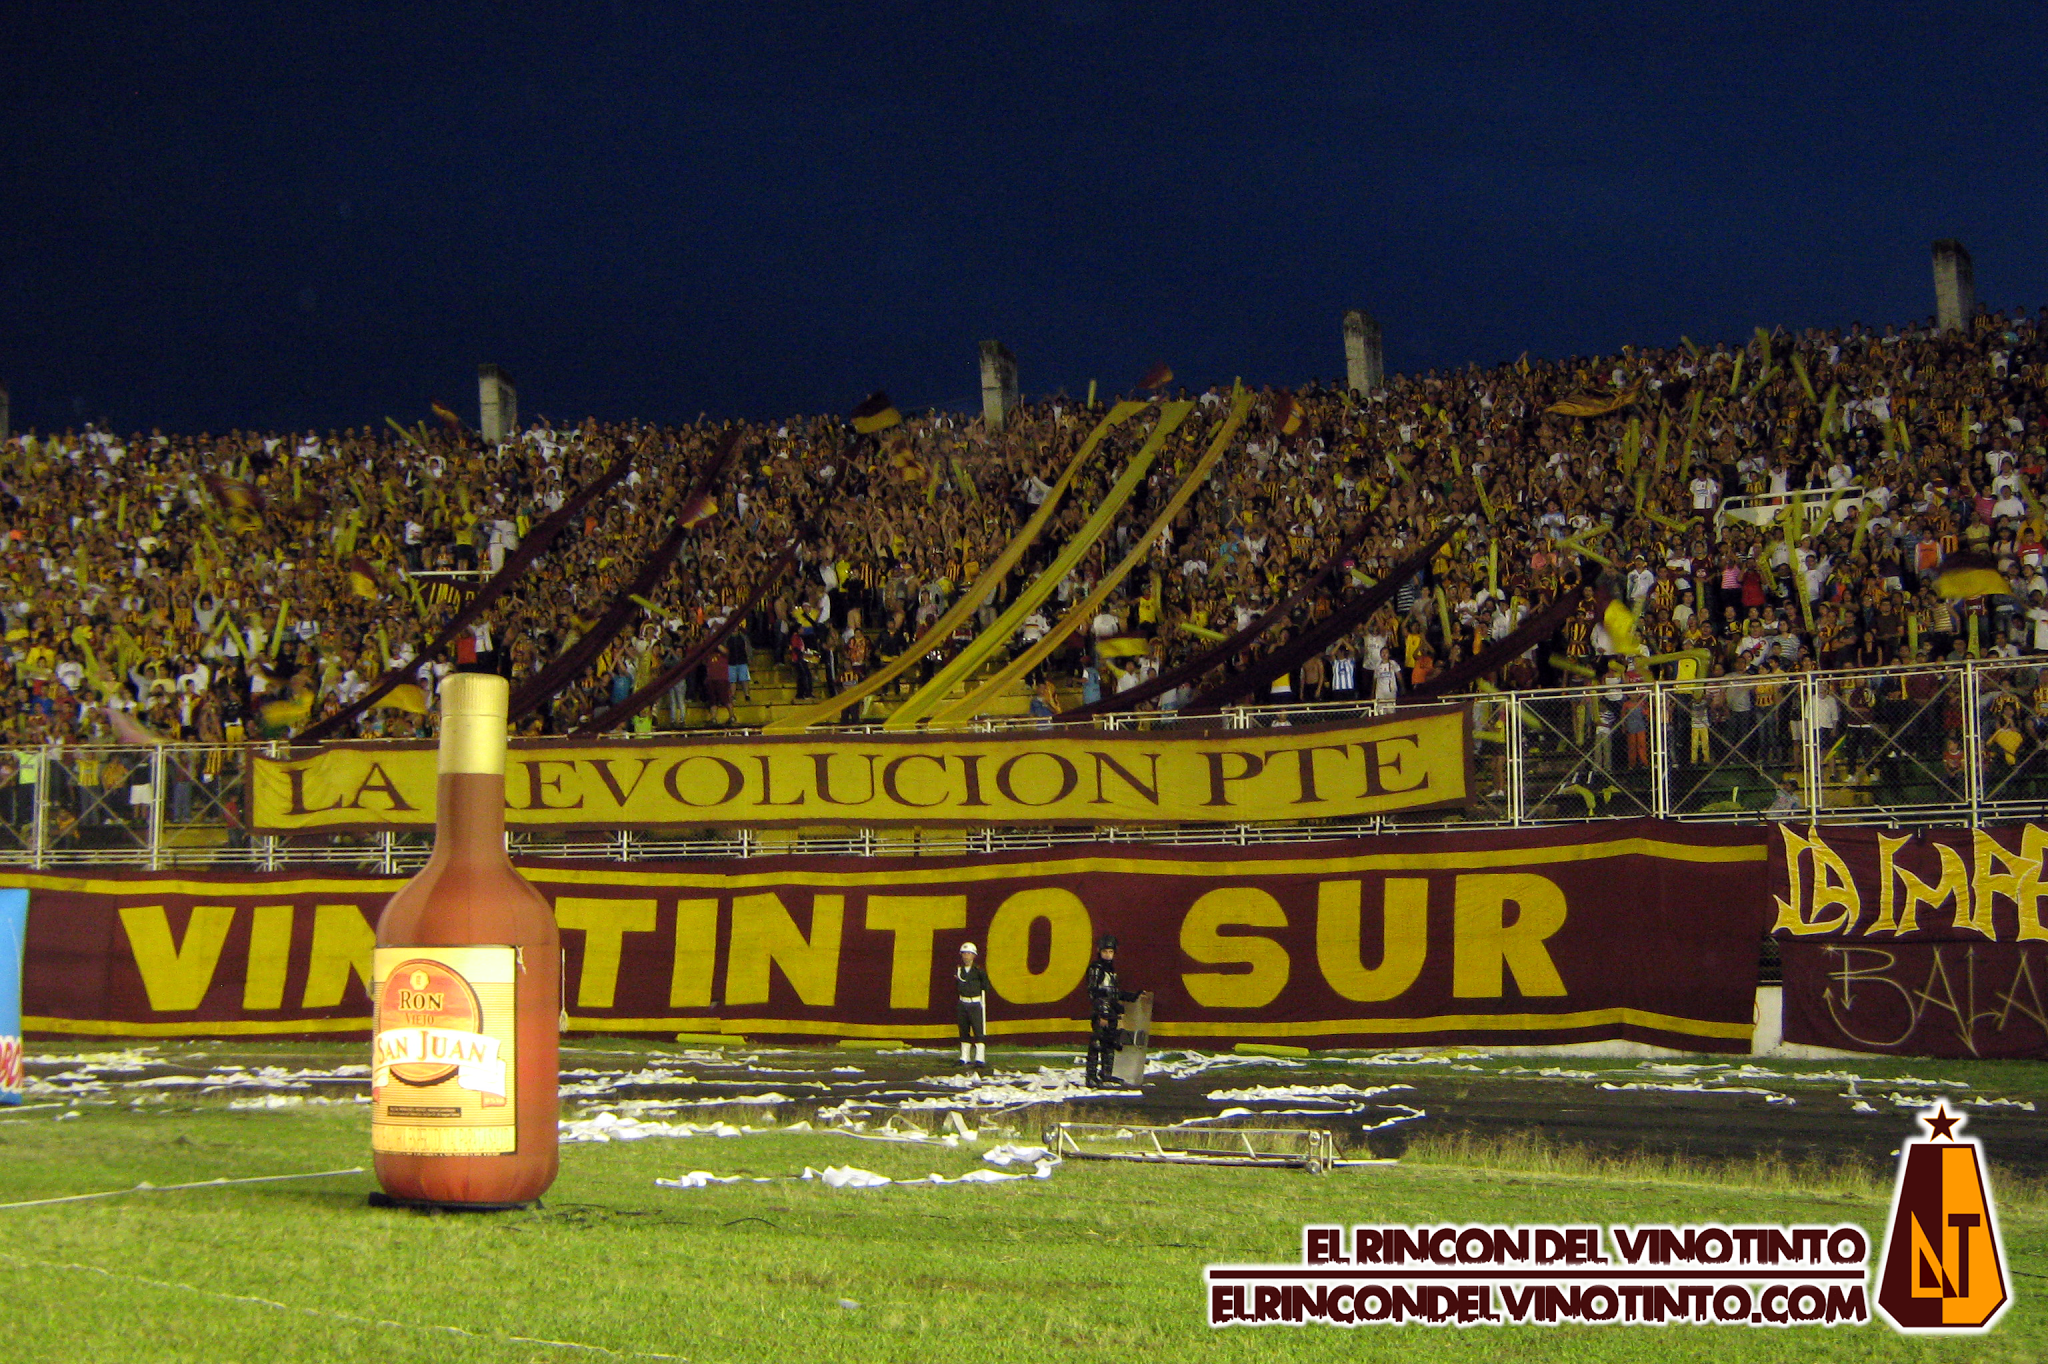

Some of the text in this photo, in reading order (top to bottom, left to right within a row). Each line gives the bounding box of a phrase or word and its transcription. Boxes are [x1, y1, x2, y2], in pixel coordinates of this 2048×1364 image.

[280, 733, 1430, 816] LA EVOLUCION PTE
[118, 873, 1568, 1012] VINTINTO SUR
[398, 990, 444, 1011] RON
[405, 1012, 435, 1026] VIEJO
[377, 1030, 487, 1064] SAN JUAN
